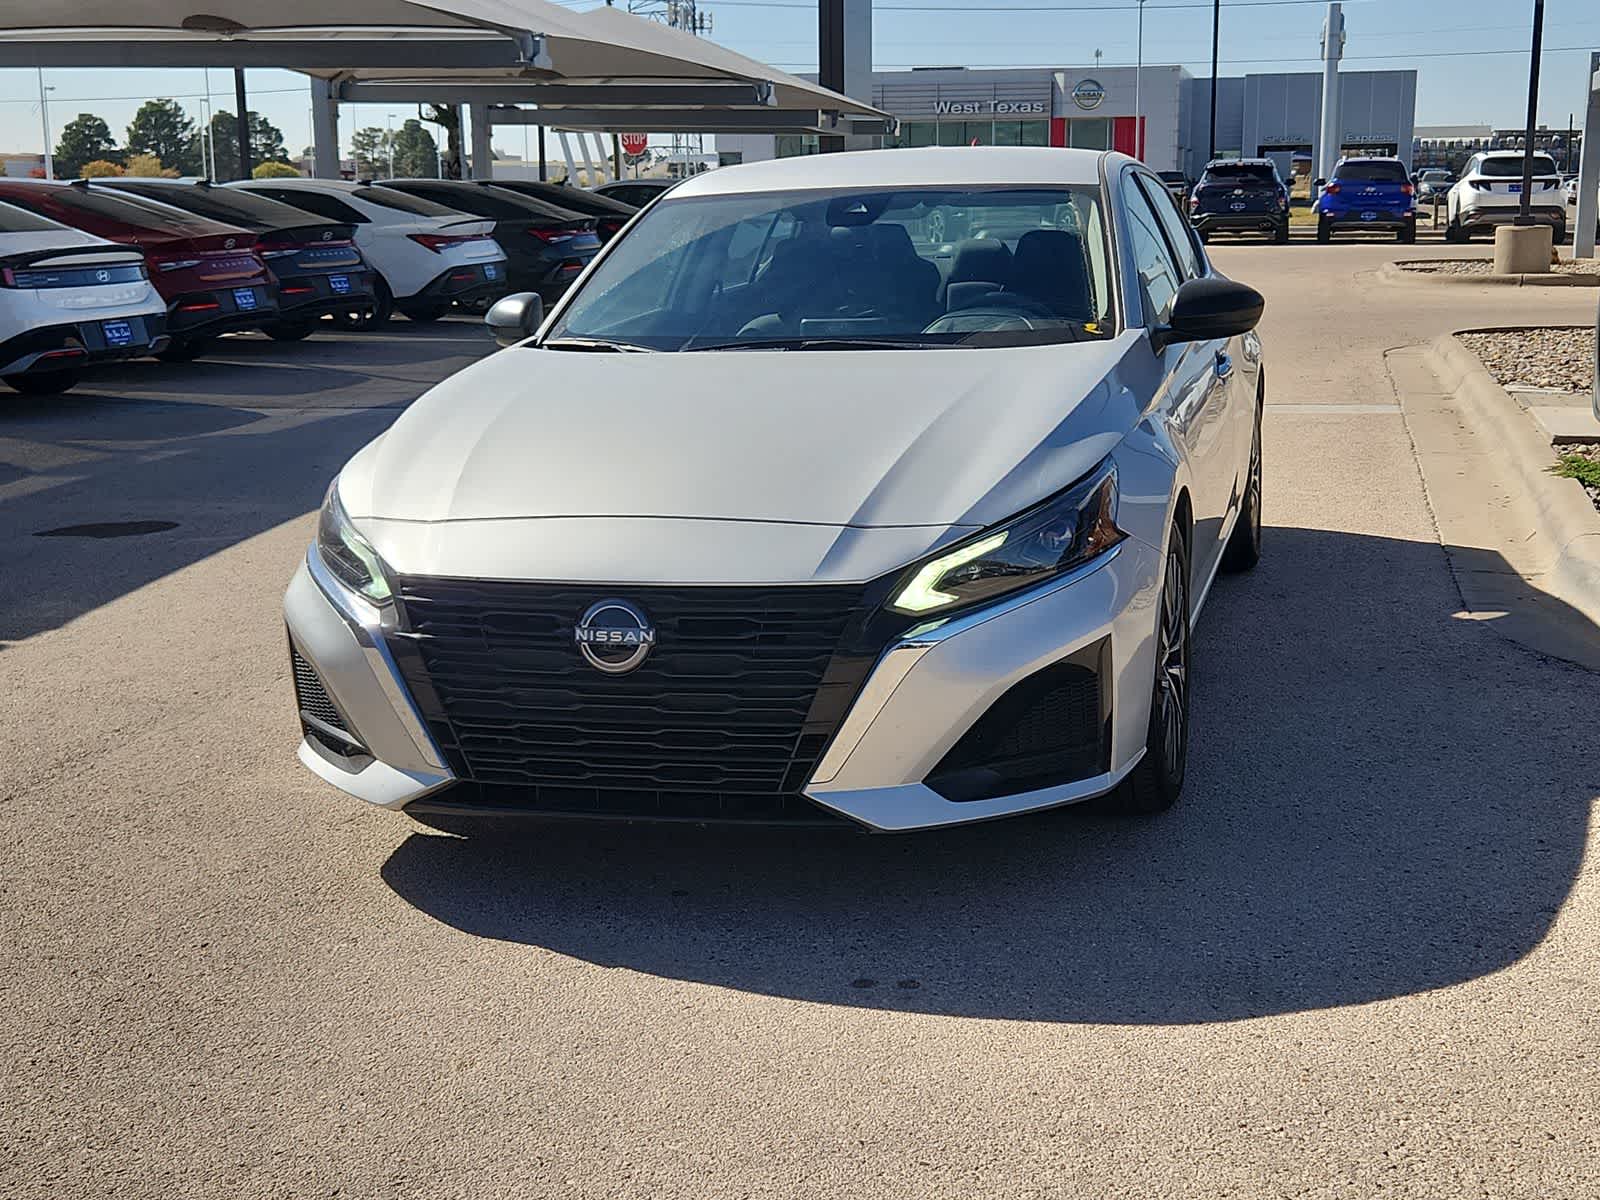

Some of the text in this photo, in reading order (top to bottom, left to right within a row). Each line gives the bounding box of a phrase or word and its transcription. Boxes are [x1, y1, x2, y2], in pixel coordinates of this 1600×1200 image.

[933, 100, 1044, 114] West Texas
[623, 133, 646, 145] STOP
[575, 629, 654, 642] NISSAN
